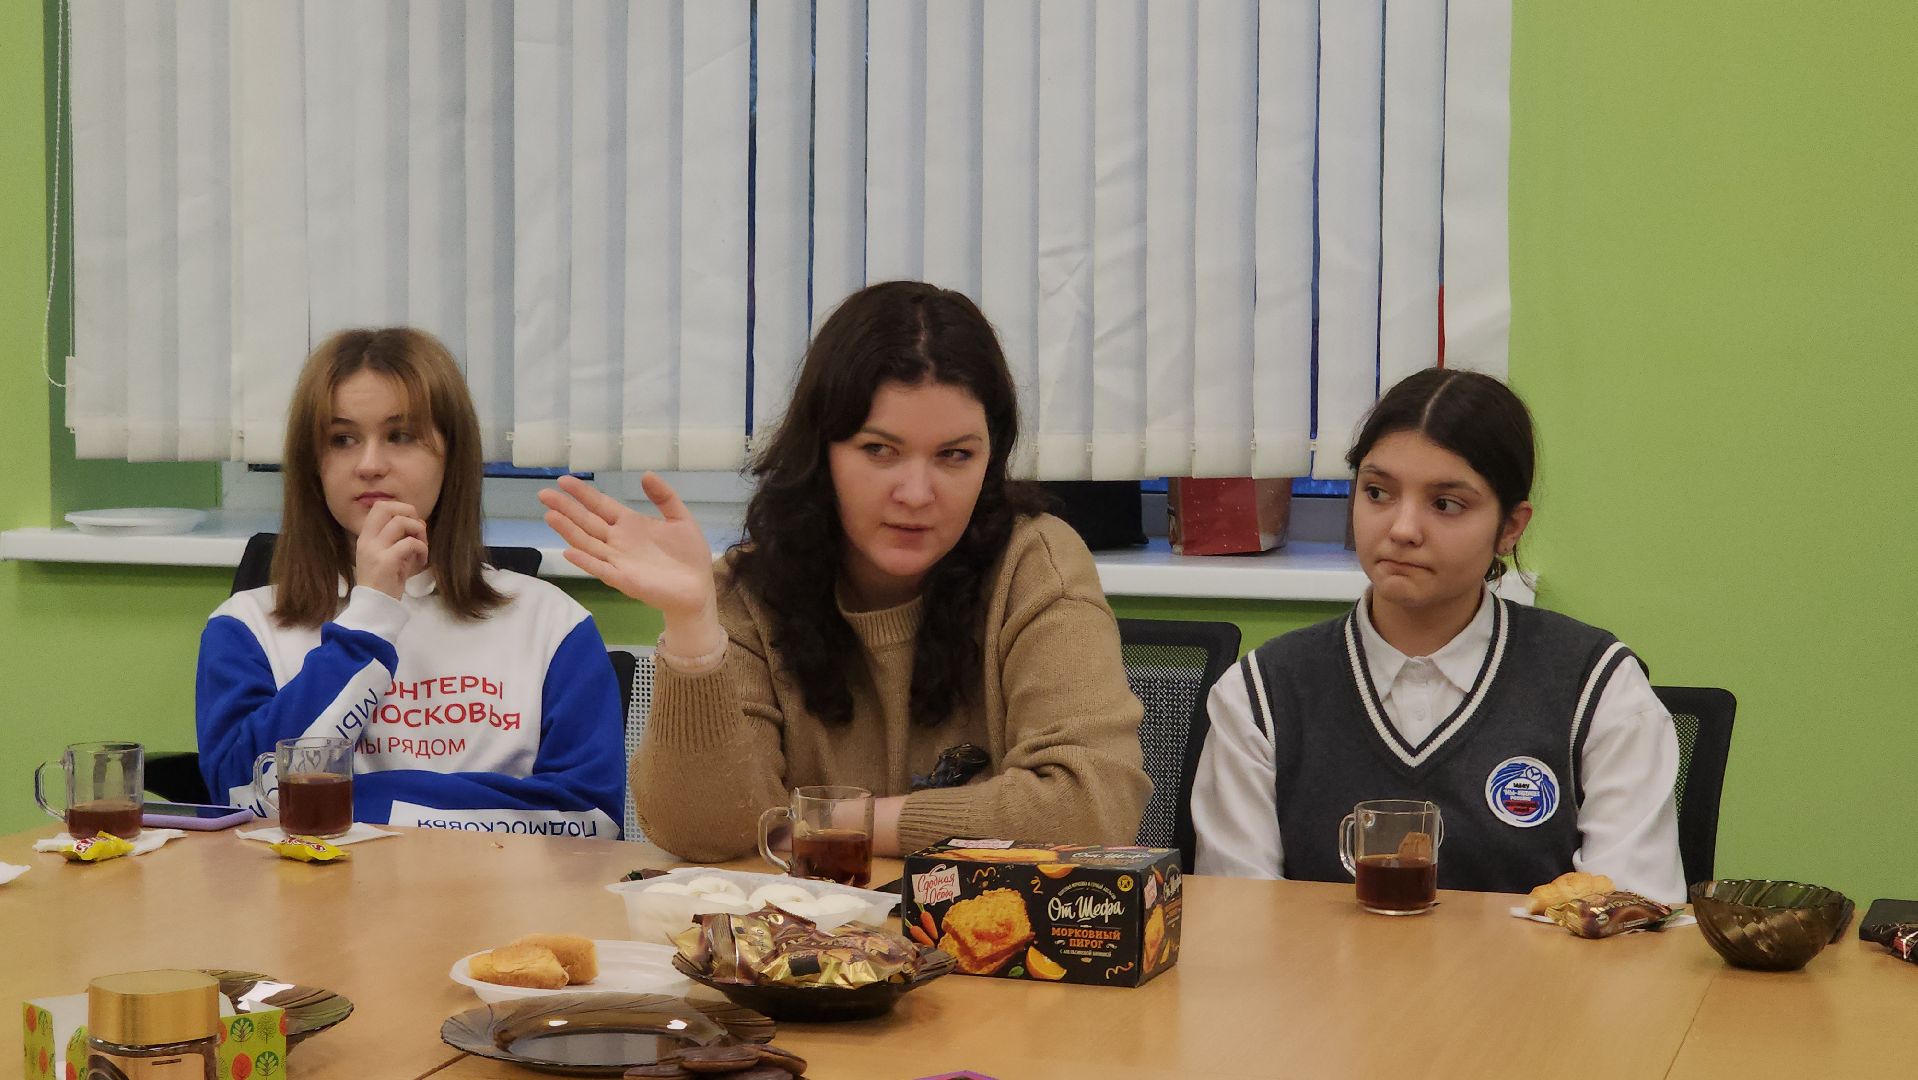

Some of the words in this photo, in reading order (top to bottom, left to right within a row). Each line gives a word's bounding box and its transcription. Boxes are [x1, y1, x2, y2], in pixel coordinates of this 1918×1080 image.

[388, 737, 466, 759] РЯДОМ
[1048, 896, 1076, 921] От
[1075, 895, 1125, 923] Шефа
[1051, 927, 1121, 940] МОРКОВНЫЙ
[1069, 938, 1104, 949] ПИРОГ
